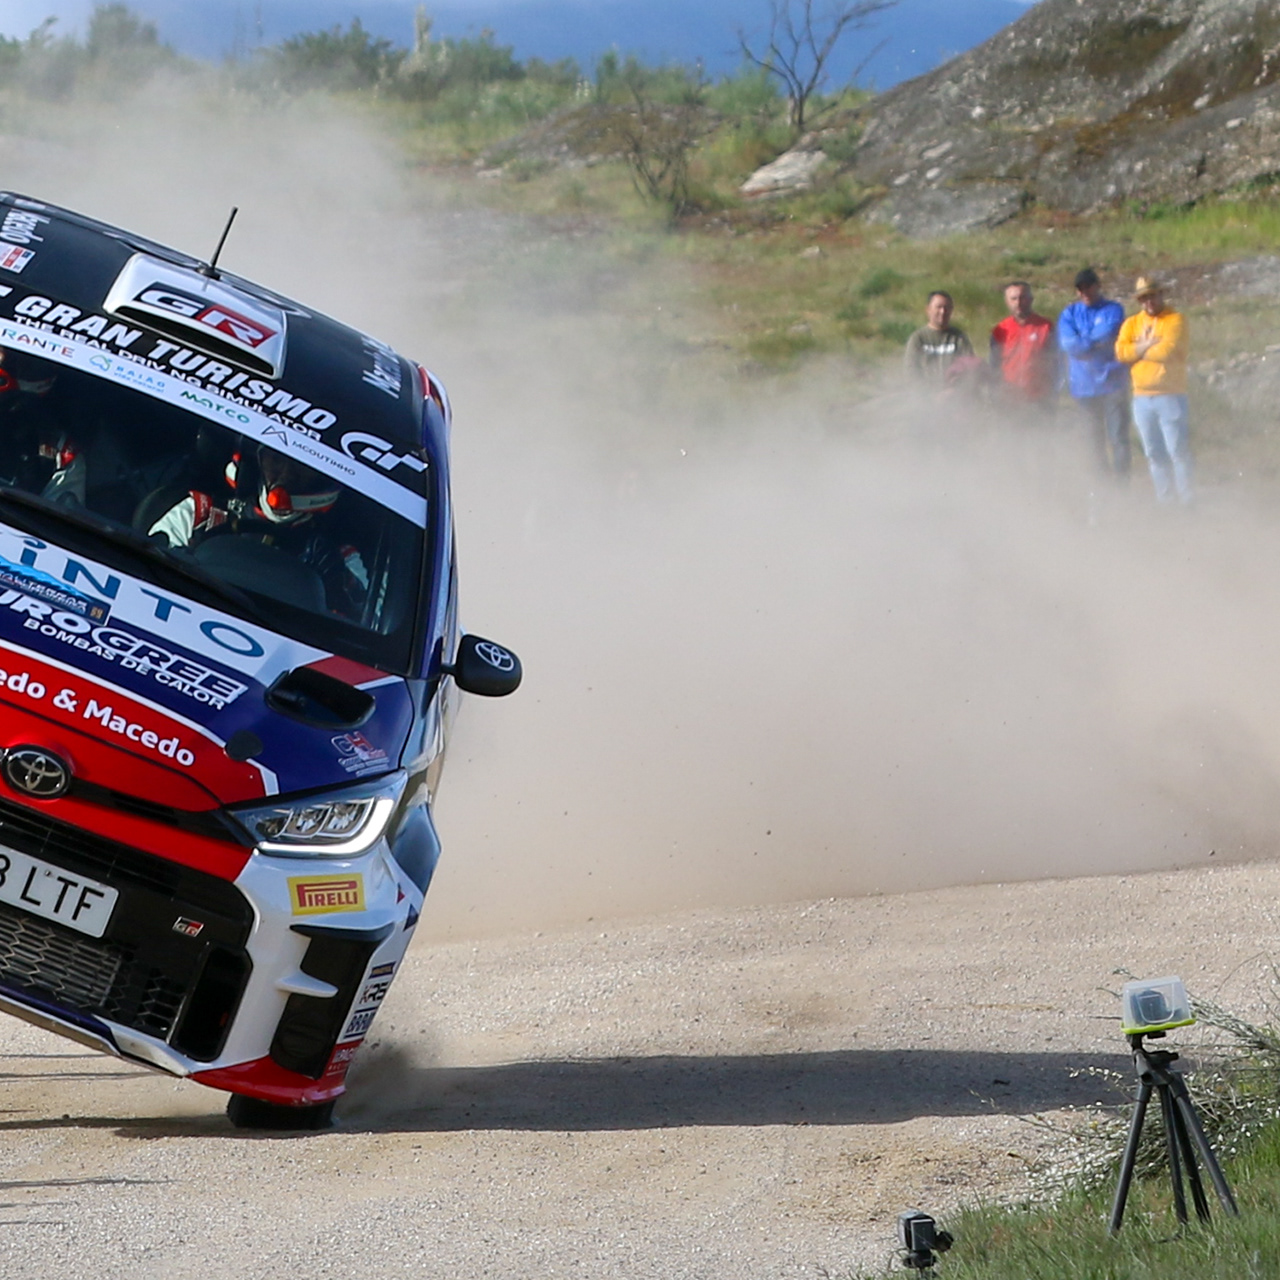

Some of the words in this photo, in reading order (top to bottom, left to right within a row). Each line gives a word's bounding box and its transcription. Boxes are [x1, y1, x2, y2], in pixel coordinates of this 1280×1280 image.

[140, 289, 265, 346] GR
[14, 314, 55, 333] THE
[60, 329, 112, 353] REAL
[119, 349, 202, 387] DRIVNG
[206, 383, 322, 442] SIMULATOR
[15, 295, 143, 348] GRAN
[148, 339, 337, 430] TURISMO
[292, 441, 356, 476] MCOUTINHO
[23, 619, 115, 662] BOMBAS
[122, 655, 149, 676] DE
[155, 670, 225, 711] CALOR
[53, 688, 78, 713] &
[83, 699, 195, 767] Macedo
[20, 866, 105, 921] LTF
[296, 881, 358, 907] PIRELLI
